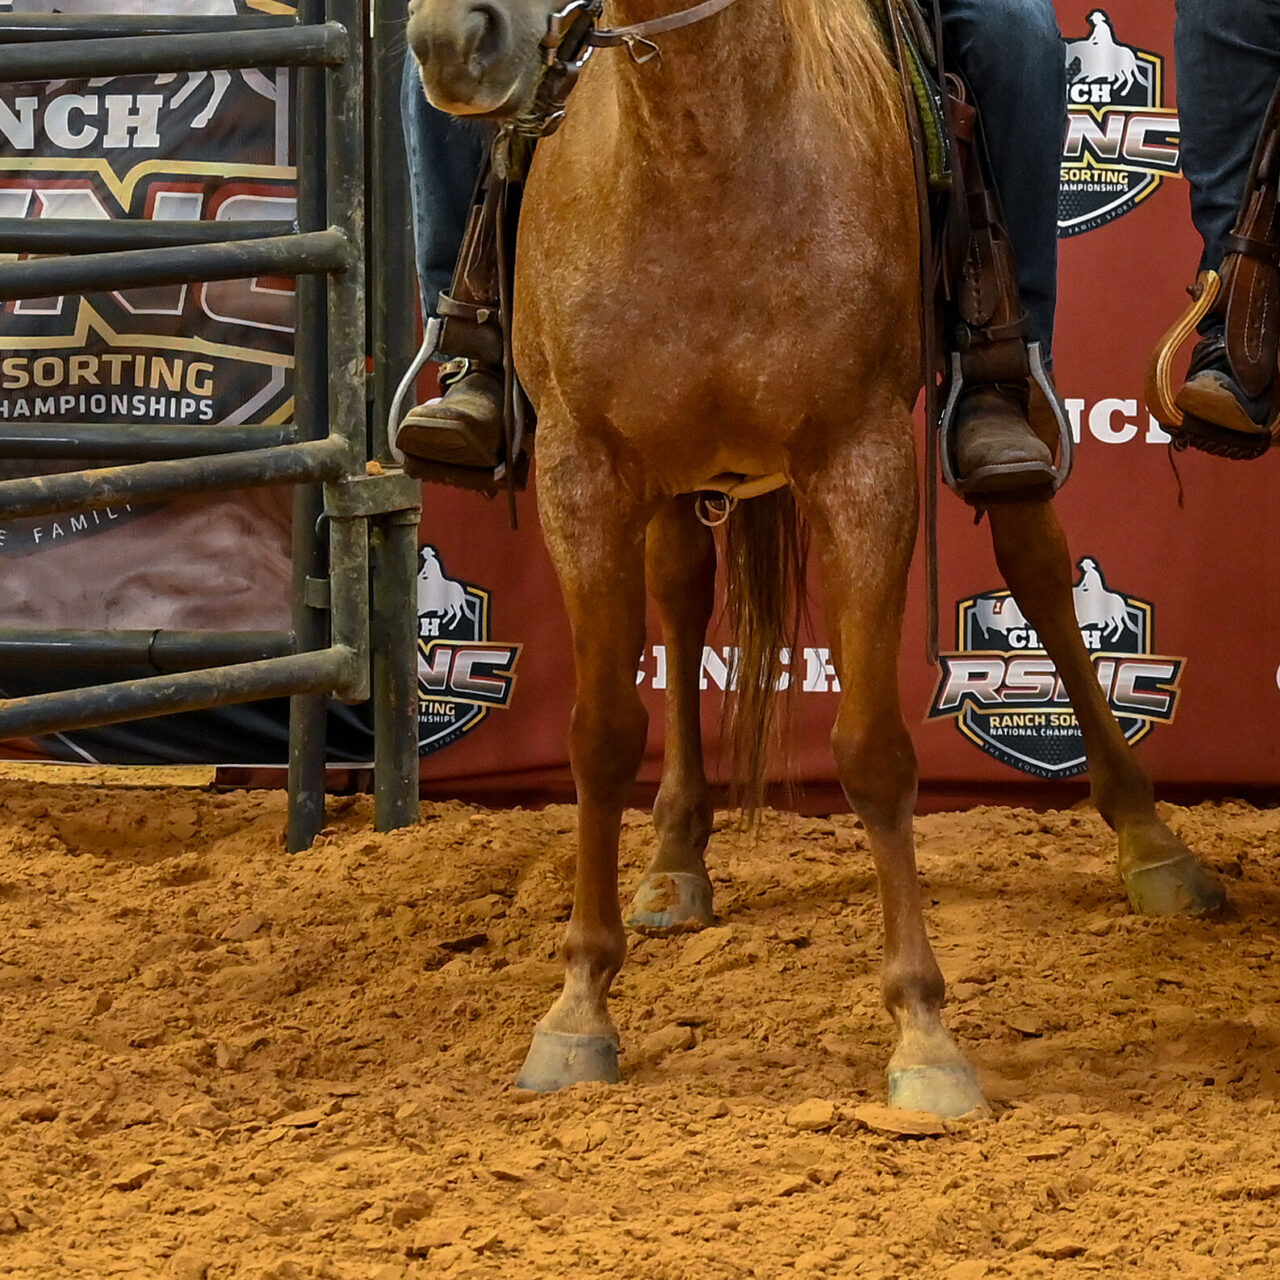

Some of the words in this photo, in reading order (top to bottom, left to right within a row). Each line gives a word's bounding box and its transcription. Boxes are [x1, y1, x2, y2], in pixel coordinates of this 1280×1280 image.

[1060, 169, 1129, 184] SORTING
[2, 354, 215, 397] SORTING
[990, 714, 1046, 728] RANCH
[990, 728, 1038, 736] NATIONAL
